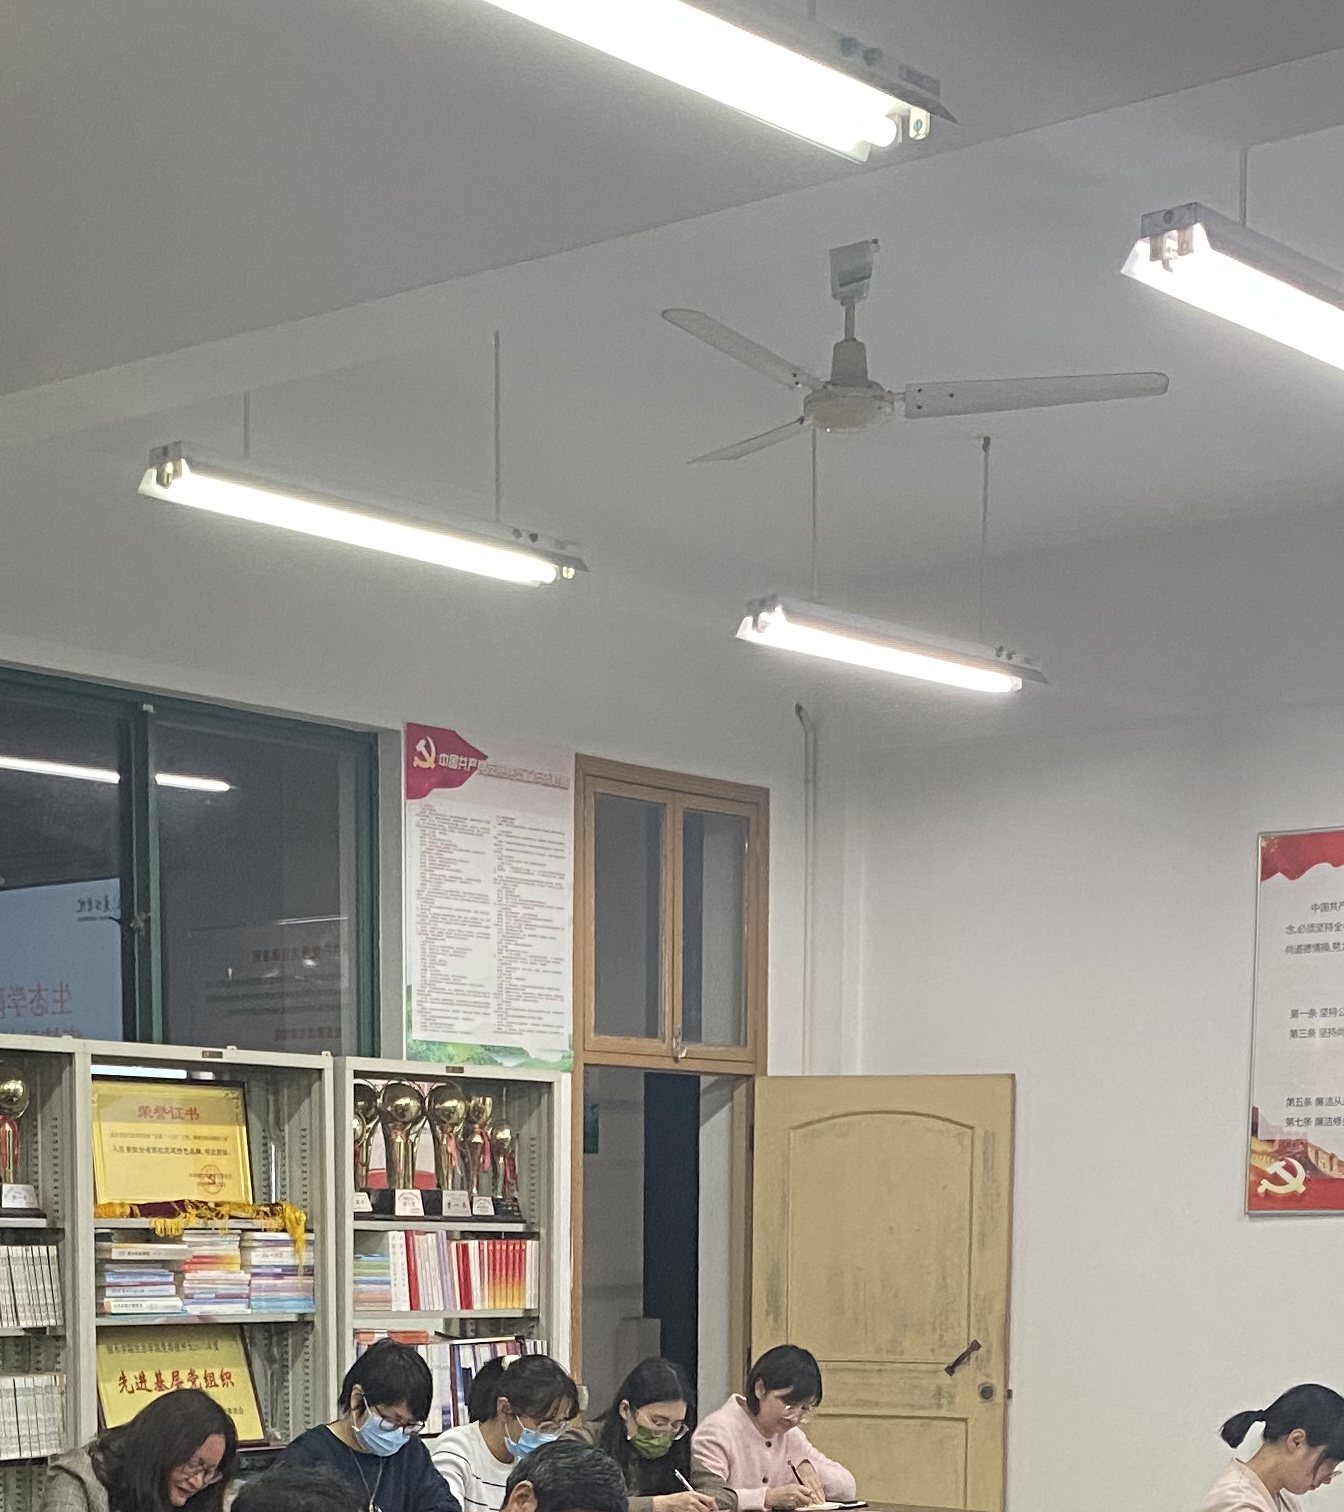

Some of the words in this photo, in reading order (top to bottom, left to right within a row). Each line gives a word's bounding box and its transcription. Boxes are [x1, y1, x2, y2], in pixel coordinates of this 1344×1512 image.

[137, 1104, 200, 1121] 荣誉证书
[118, 1367, 235, 1395] 先进基层党组织
